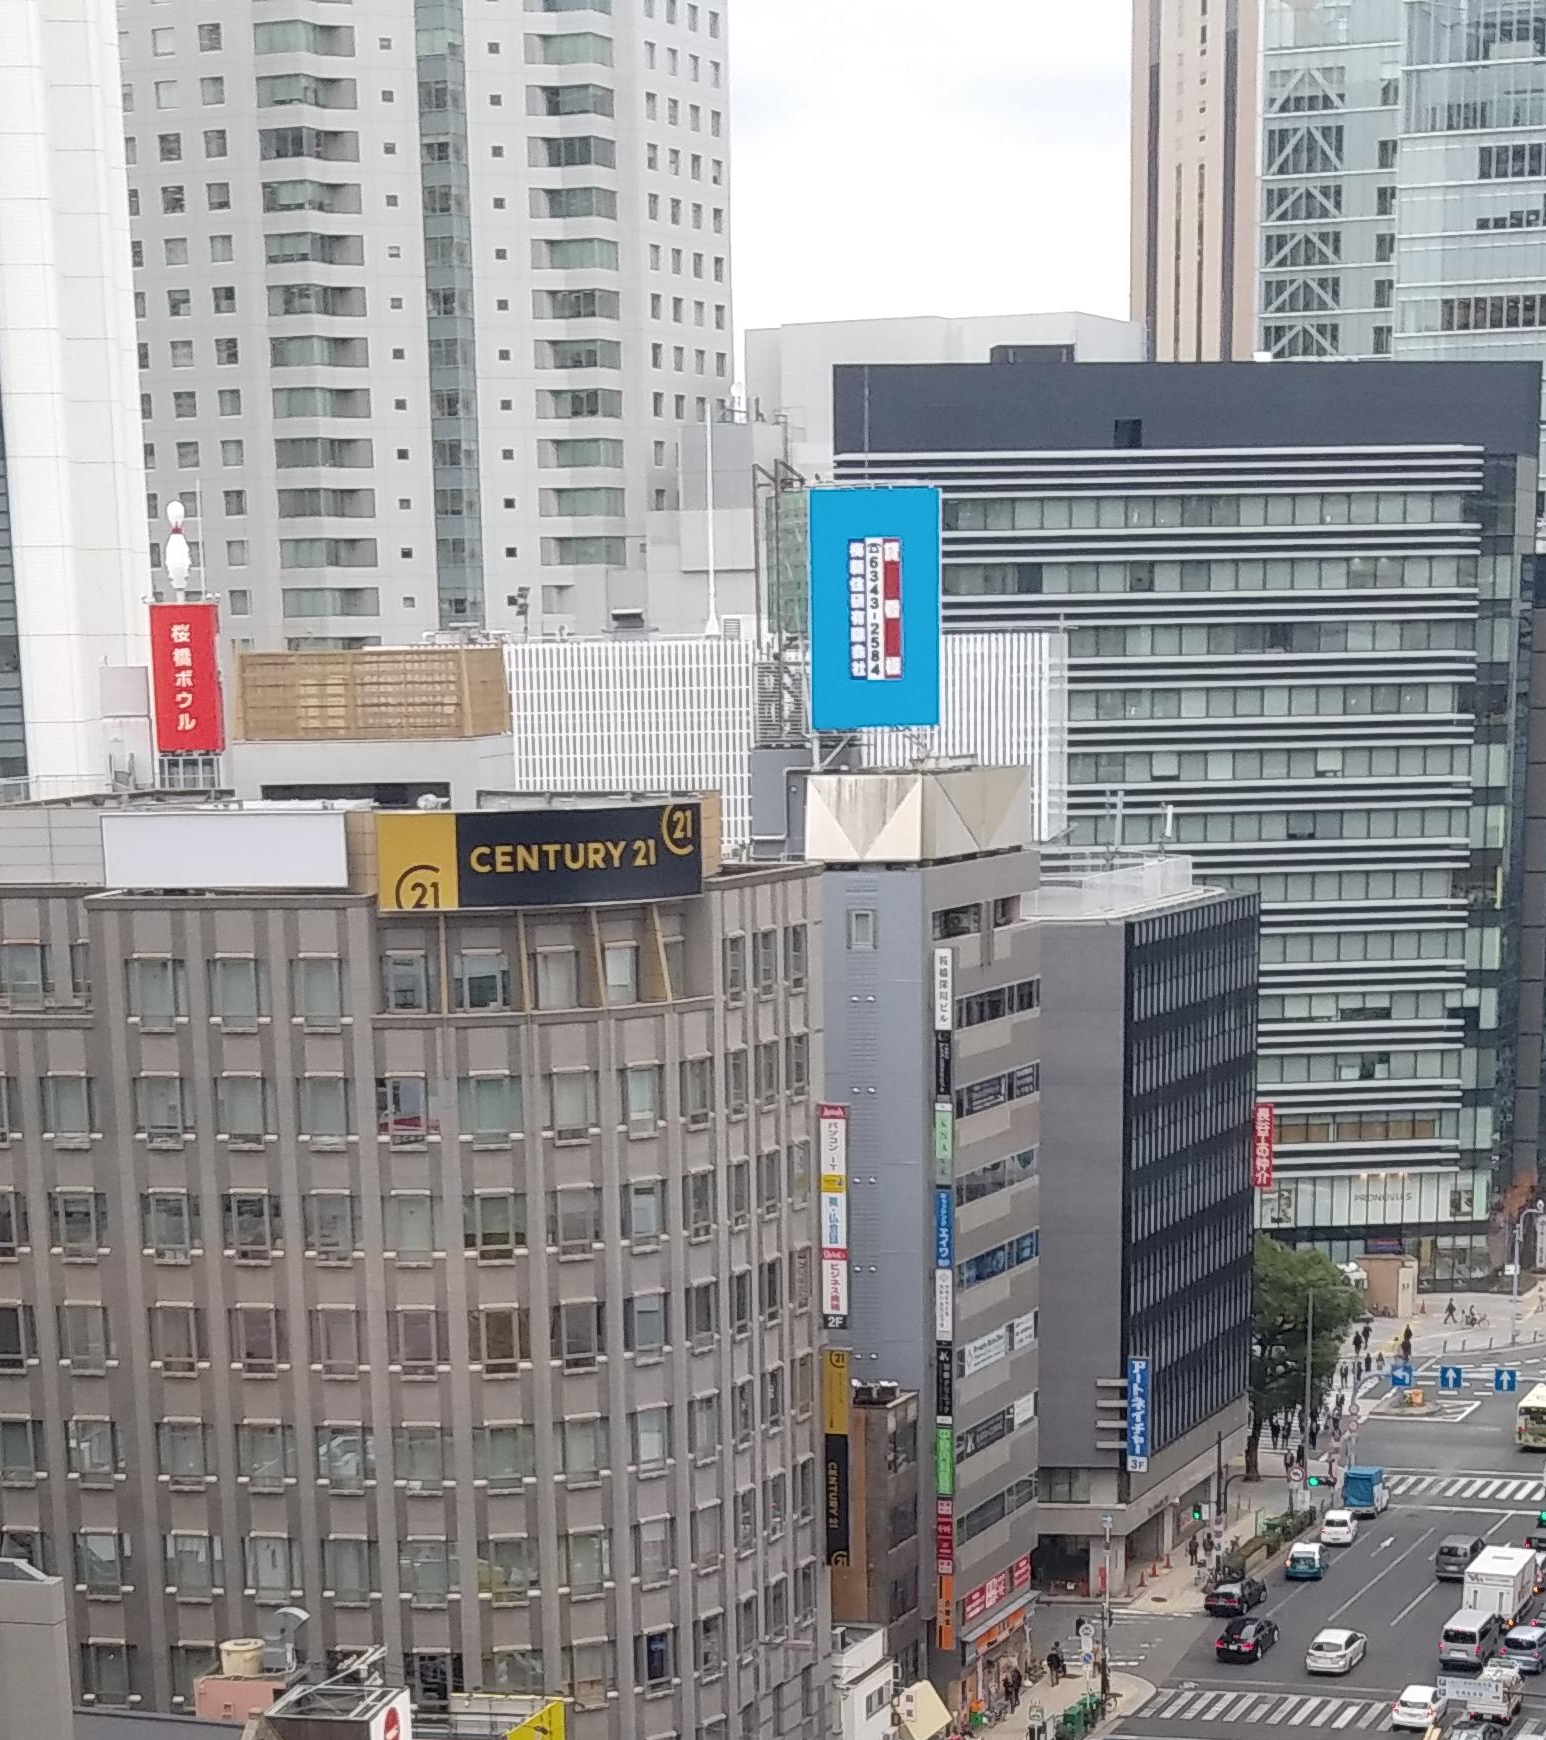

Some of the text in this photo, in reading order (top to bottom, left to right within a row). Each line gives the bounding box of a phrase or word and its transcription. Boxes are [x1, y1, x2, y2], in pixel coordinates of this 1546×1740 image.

[171, 623, 196, 731] 桜橋ボウル
[469, 838, 657, 874] CENTURY 21
[827, 1316, 843, 1328] 2F
[1131, 1361, 1146, 1454] アートネイチャー
[1131, 1459, 1144, 1469] 3F
